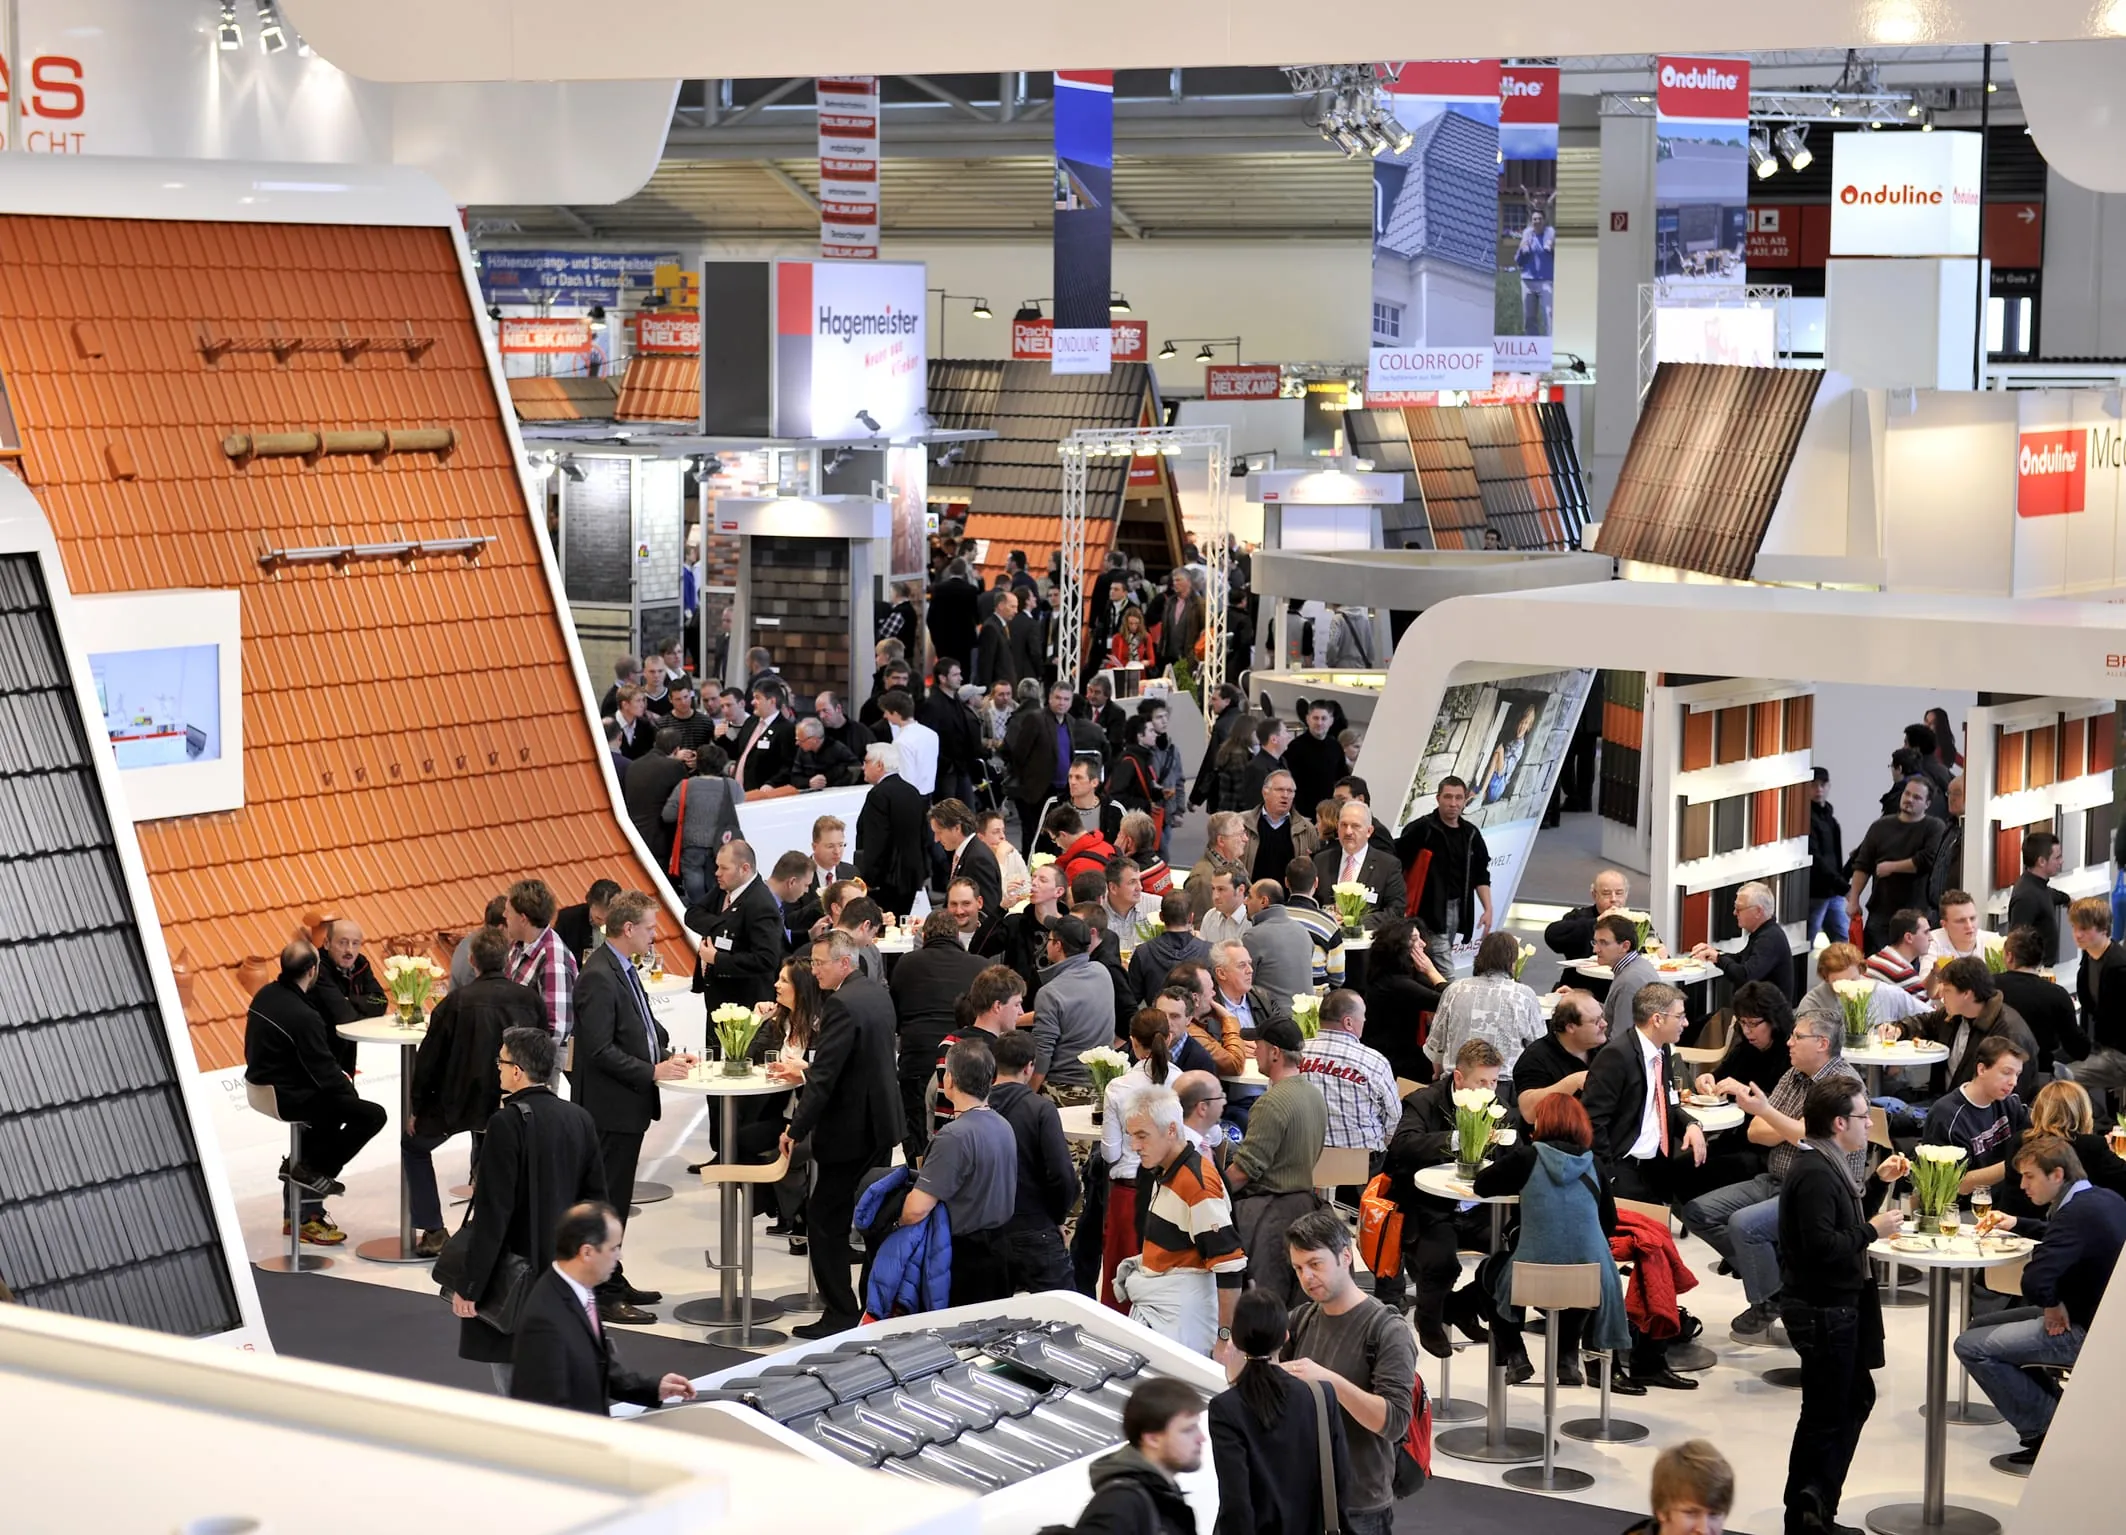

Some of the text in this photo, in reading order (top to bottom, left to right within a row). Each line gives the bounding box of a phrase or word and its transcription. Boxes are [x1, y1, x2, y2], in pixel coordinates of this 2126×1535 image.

[1661, 65, 1737, 91] Onduline
[1840, 184, 1943, 205] Onduline
[559, 273, 584, 287] Dach
[819, 304, 918, 344] Hagemeister
[503, 333, 589, 348] NELSKAMP
[1379, 353, 1484, 371] COLORROOF
[1210, 380, 1277, 396] NELSKAMP
[2019, 444, 2076, 476] Onduline
